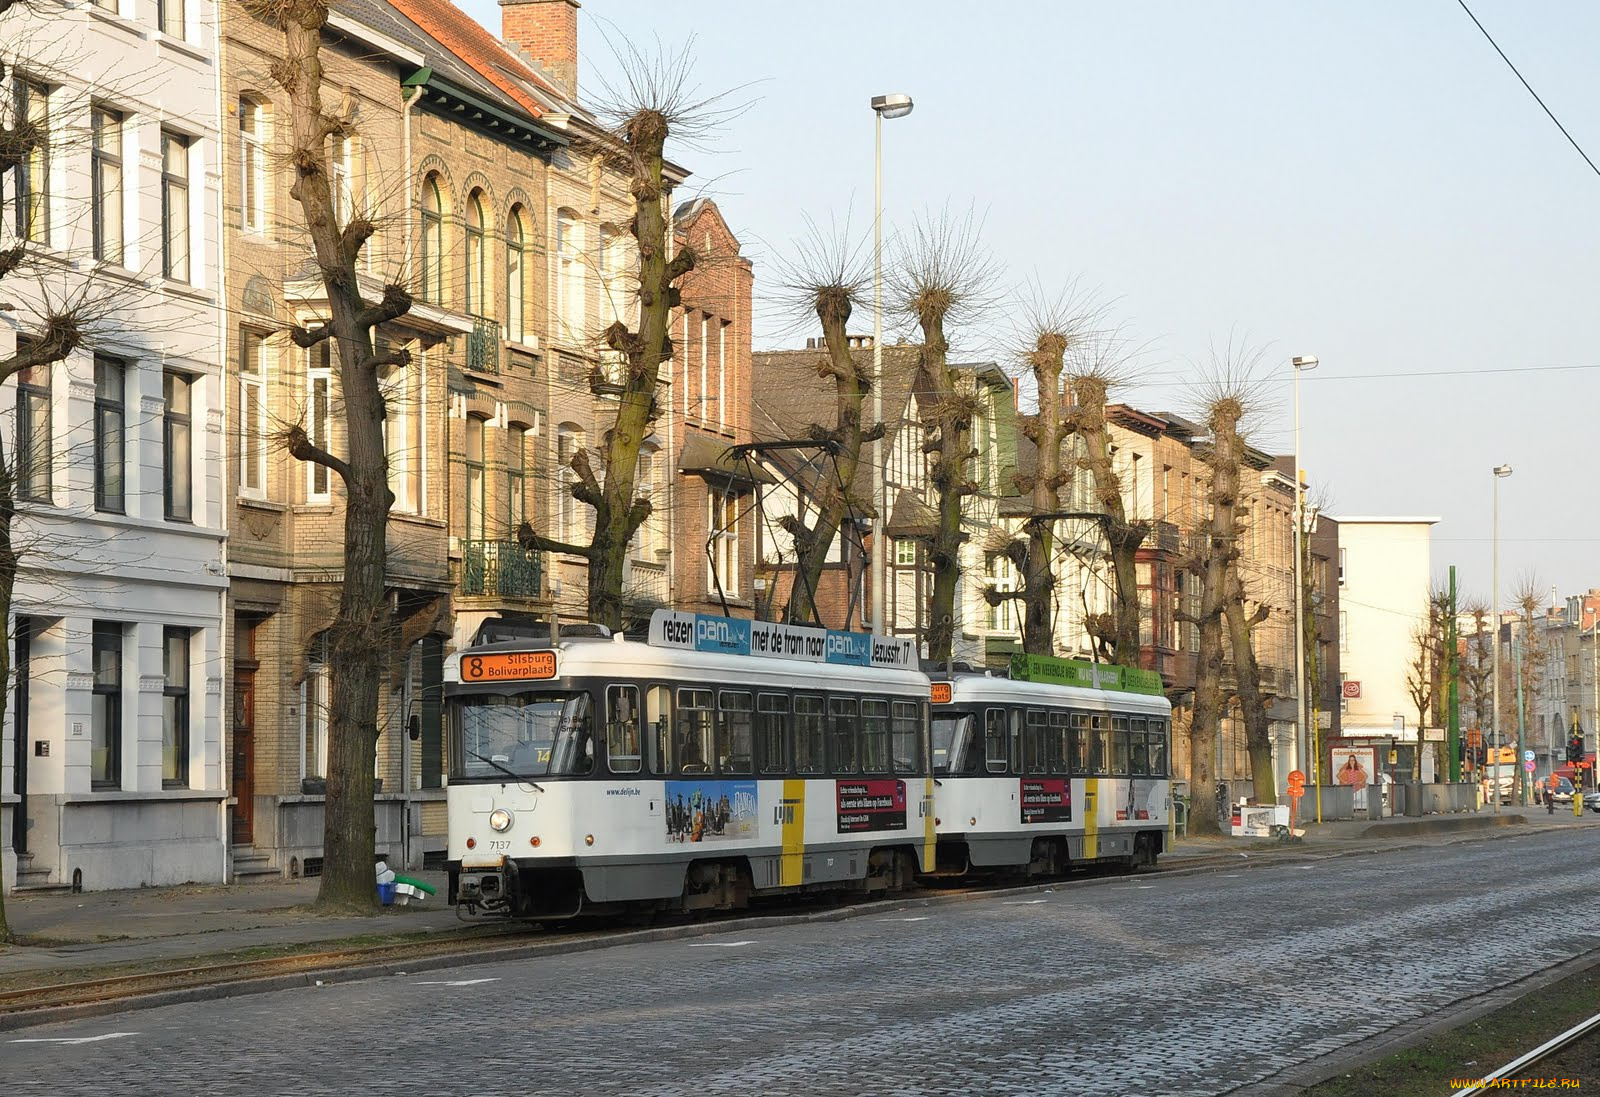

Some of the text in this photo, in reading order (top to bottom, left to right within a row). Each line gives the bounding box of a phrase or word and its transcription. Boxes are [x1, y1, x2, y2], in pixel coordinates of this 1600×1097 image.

[663, 613, 693, 644] reizen
[697, 619, 730, 645] pam
[752, 626, 826, 658] met de tram naar
[828, 634, 852, 656] pam
[871, 637, 911, 665] Jezusstr. 17
[470, 657, 484, 677] 8
[508, 653, 553, 667] Silsburg
[488, 664, 553, 677] Bolivarplaats
[930, 692, 949, 700] aats
[606, 787, 641, 797] www.delijn.be
[489, 840, 511, 850] 7137
